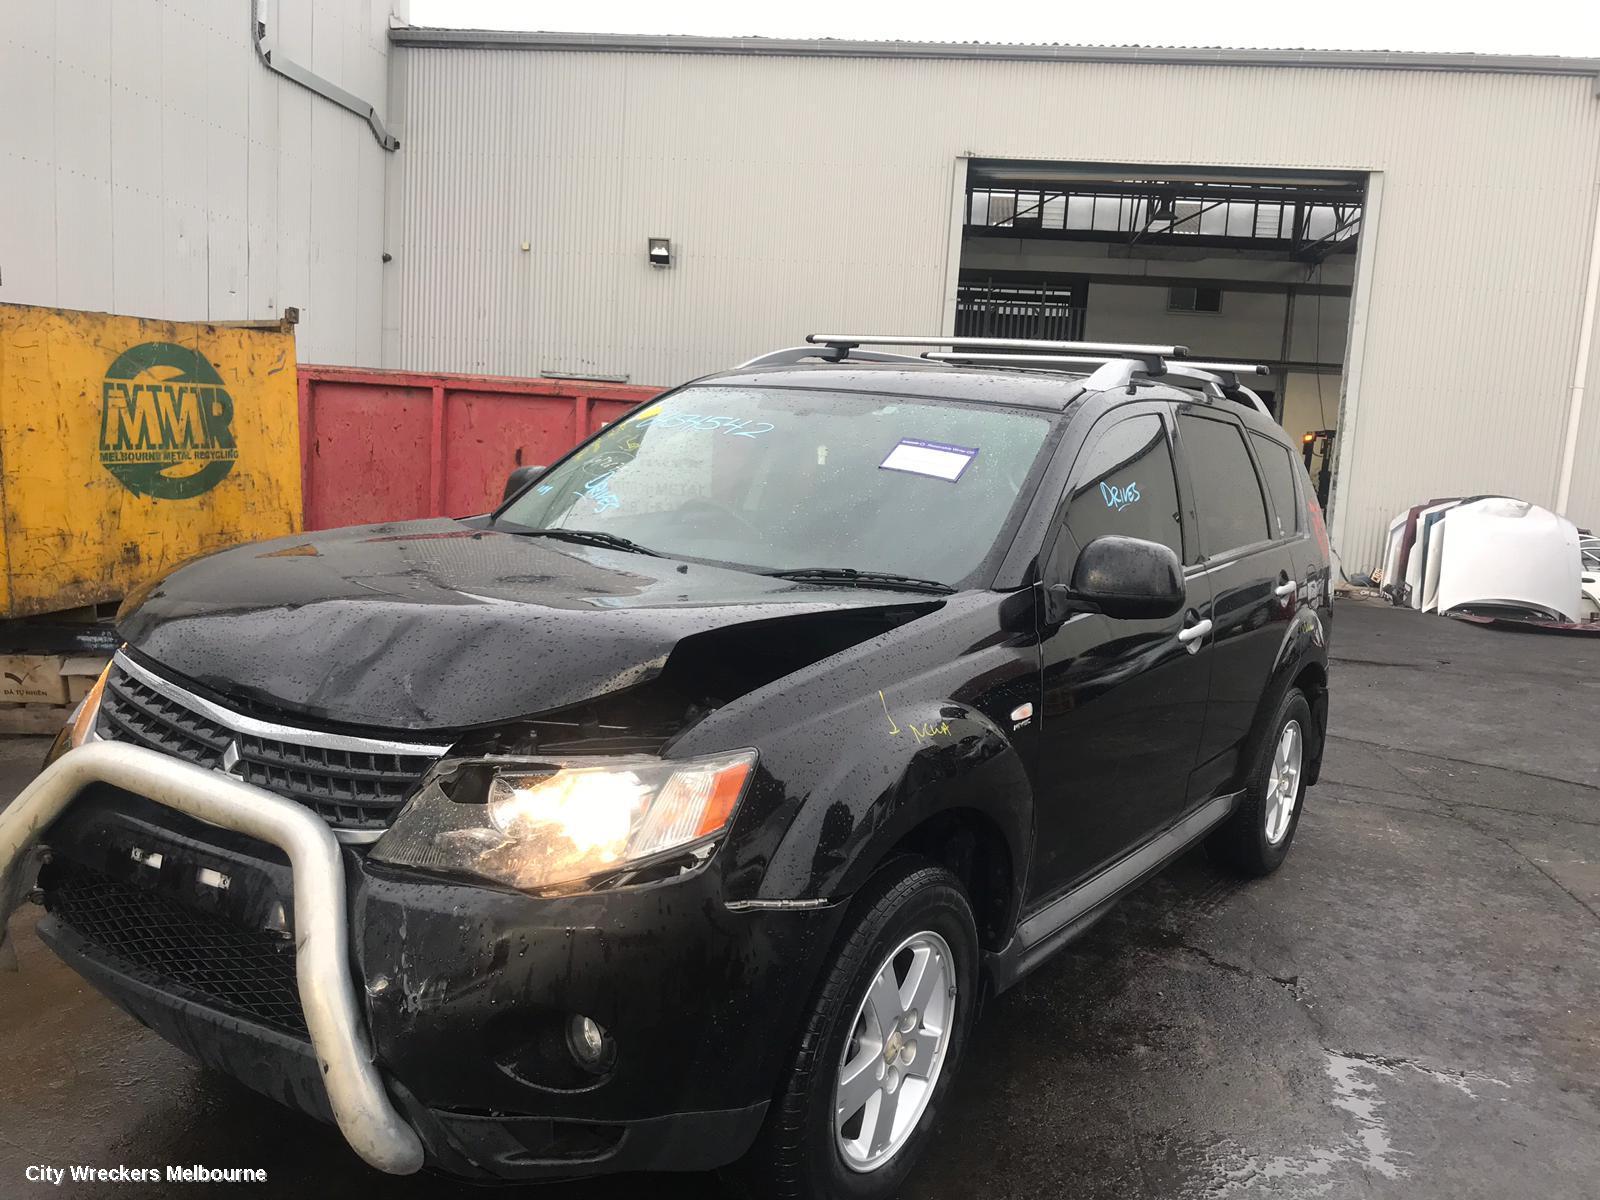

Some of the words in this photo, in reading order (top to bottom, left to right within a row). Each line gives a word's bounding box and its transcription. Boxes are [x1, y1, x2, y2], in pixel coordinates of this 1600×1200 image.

[99, 382, 237, 450] MMR
[163, 451, 192, 461] METAL
[1099, 481, 1141, 508] DRIVES
